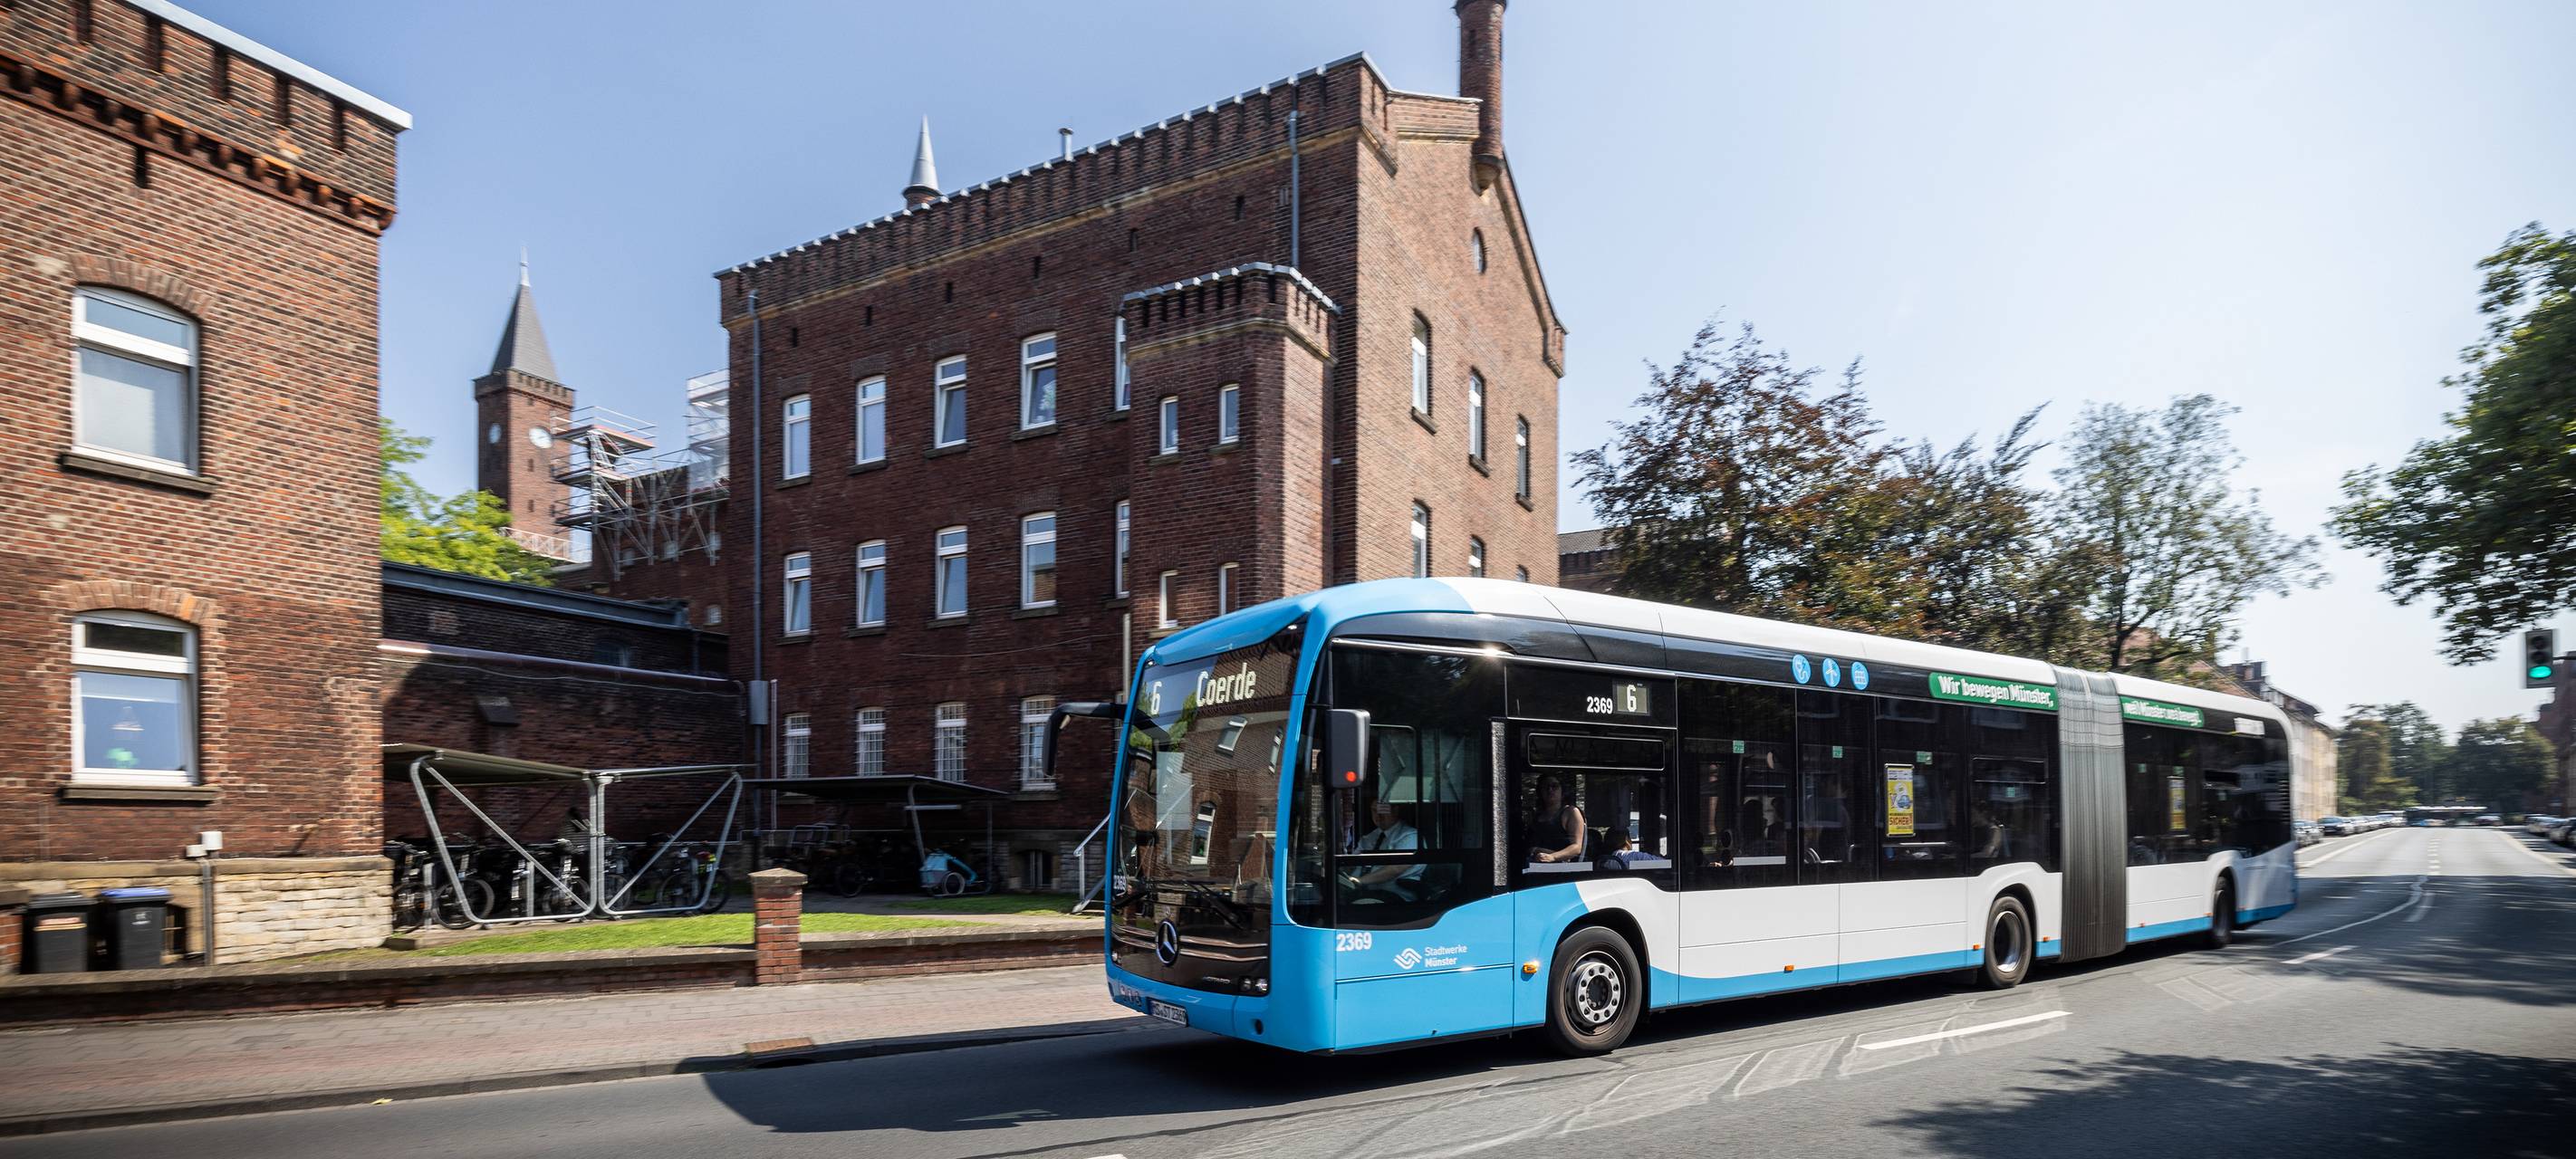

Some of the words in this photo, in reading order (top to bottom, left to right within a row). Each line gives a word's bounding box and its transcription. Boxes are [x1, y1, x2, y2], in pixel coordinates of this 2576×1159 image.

[1150, 681, 1162, 714] 6
[1196, 662, 1257, 706] Coerde
[1626, 684, 1638, 712] 6
[1937, 675, 1960, 694] Wir
[1960, 678, 2009, 703] bewegen
[2008, 685, 2053, 707] Münster,
[1586, 695, 1613, 714] 2369
[1335, 932, 1372, 952] 2369
[1424, 943, 1468, 957] Stadtwerke
[1424, 957, 1457, 968] Münster
